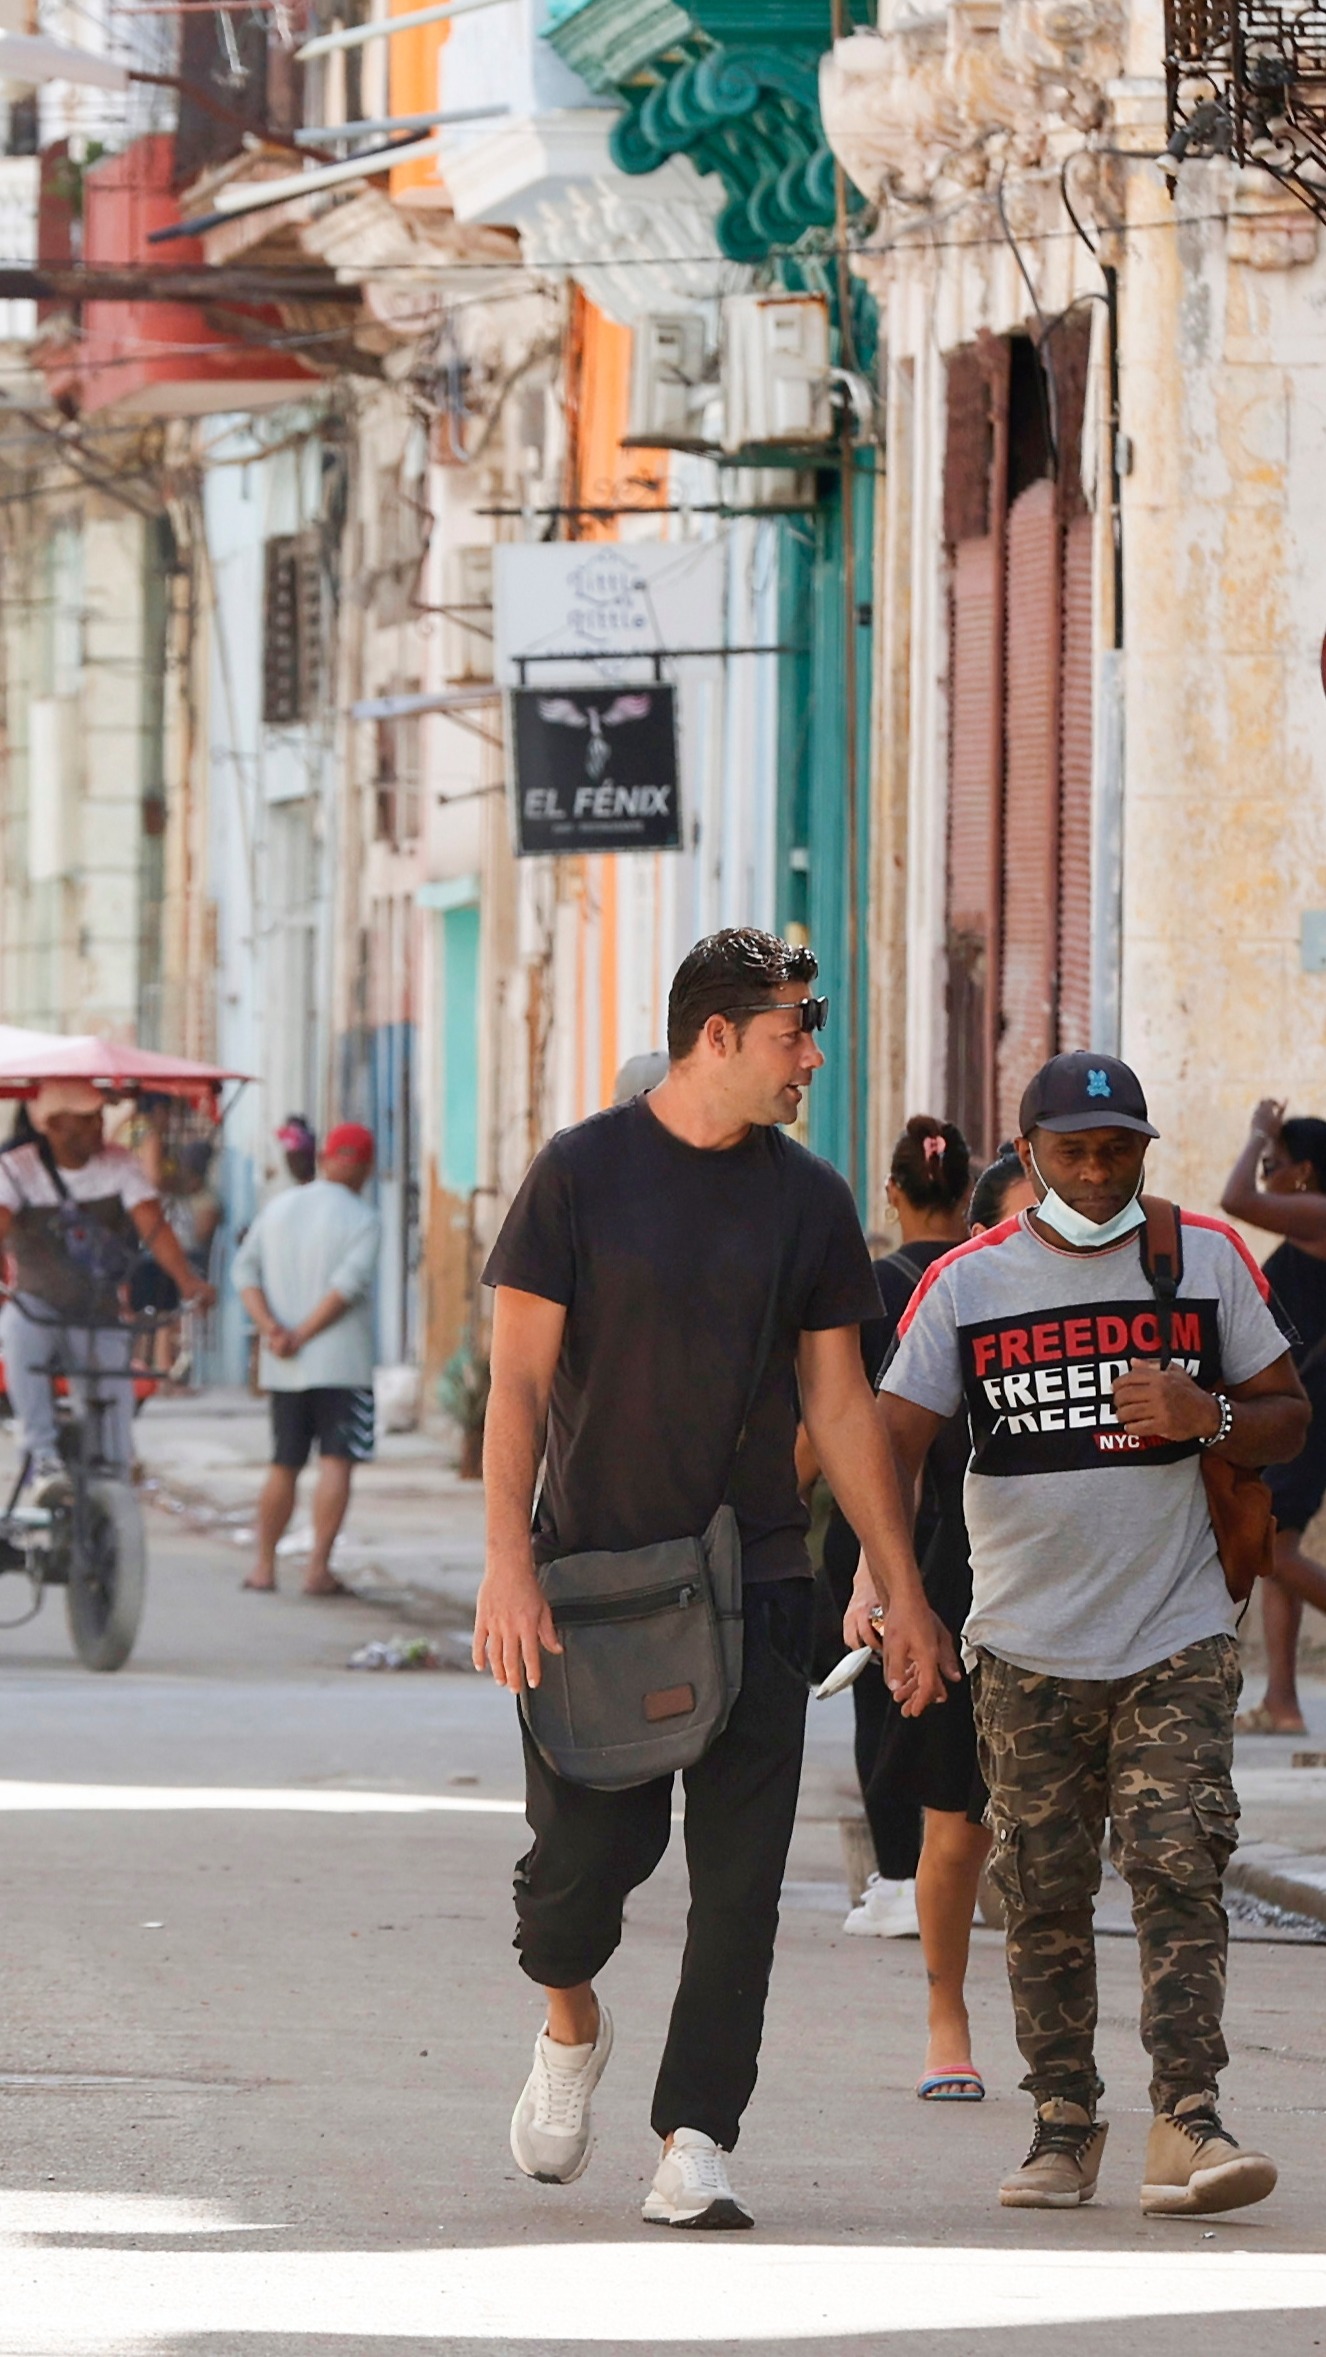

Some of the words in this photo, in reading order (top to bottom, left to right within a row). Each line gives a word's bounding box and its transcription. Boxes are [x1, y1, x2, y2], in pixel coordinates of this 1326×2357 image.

[525, 787, 566, 820] EL
[573, 777, 671, 818] FÉNIX
[972, 1313, 1201, 1376] FREEDOM
[983, 1358, 1201, 1410] FREED
[1099, 1435, 1140, 1450] NYC
